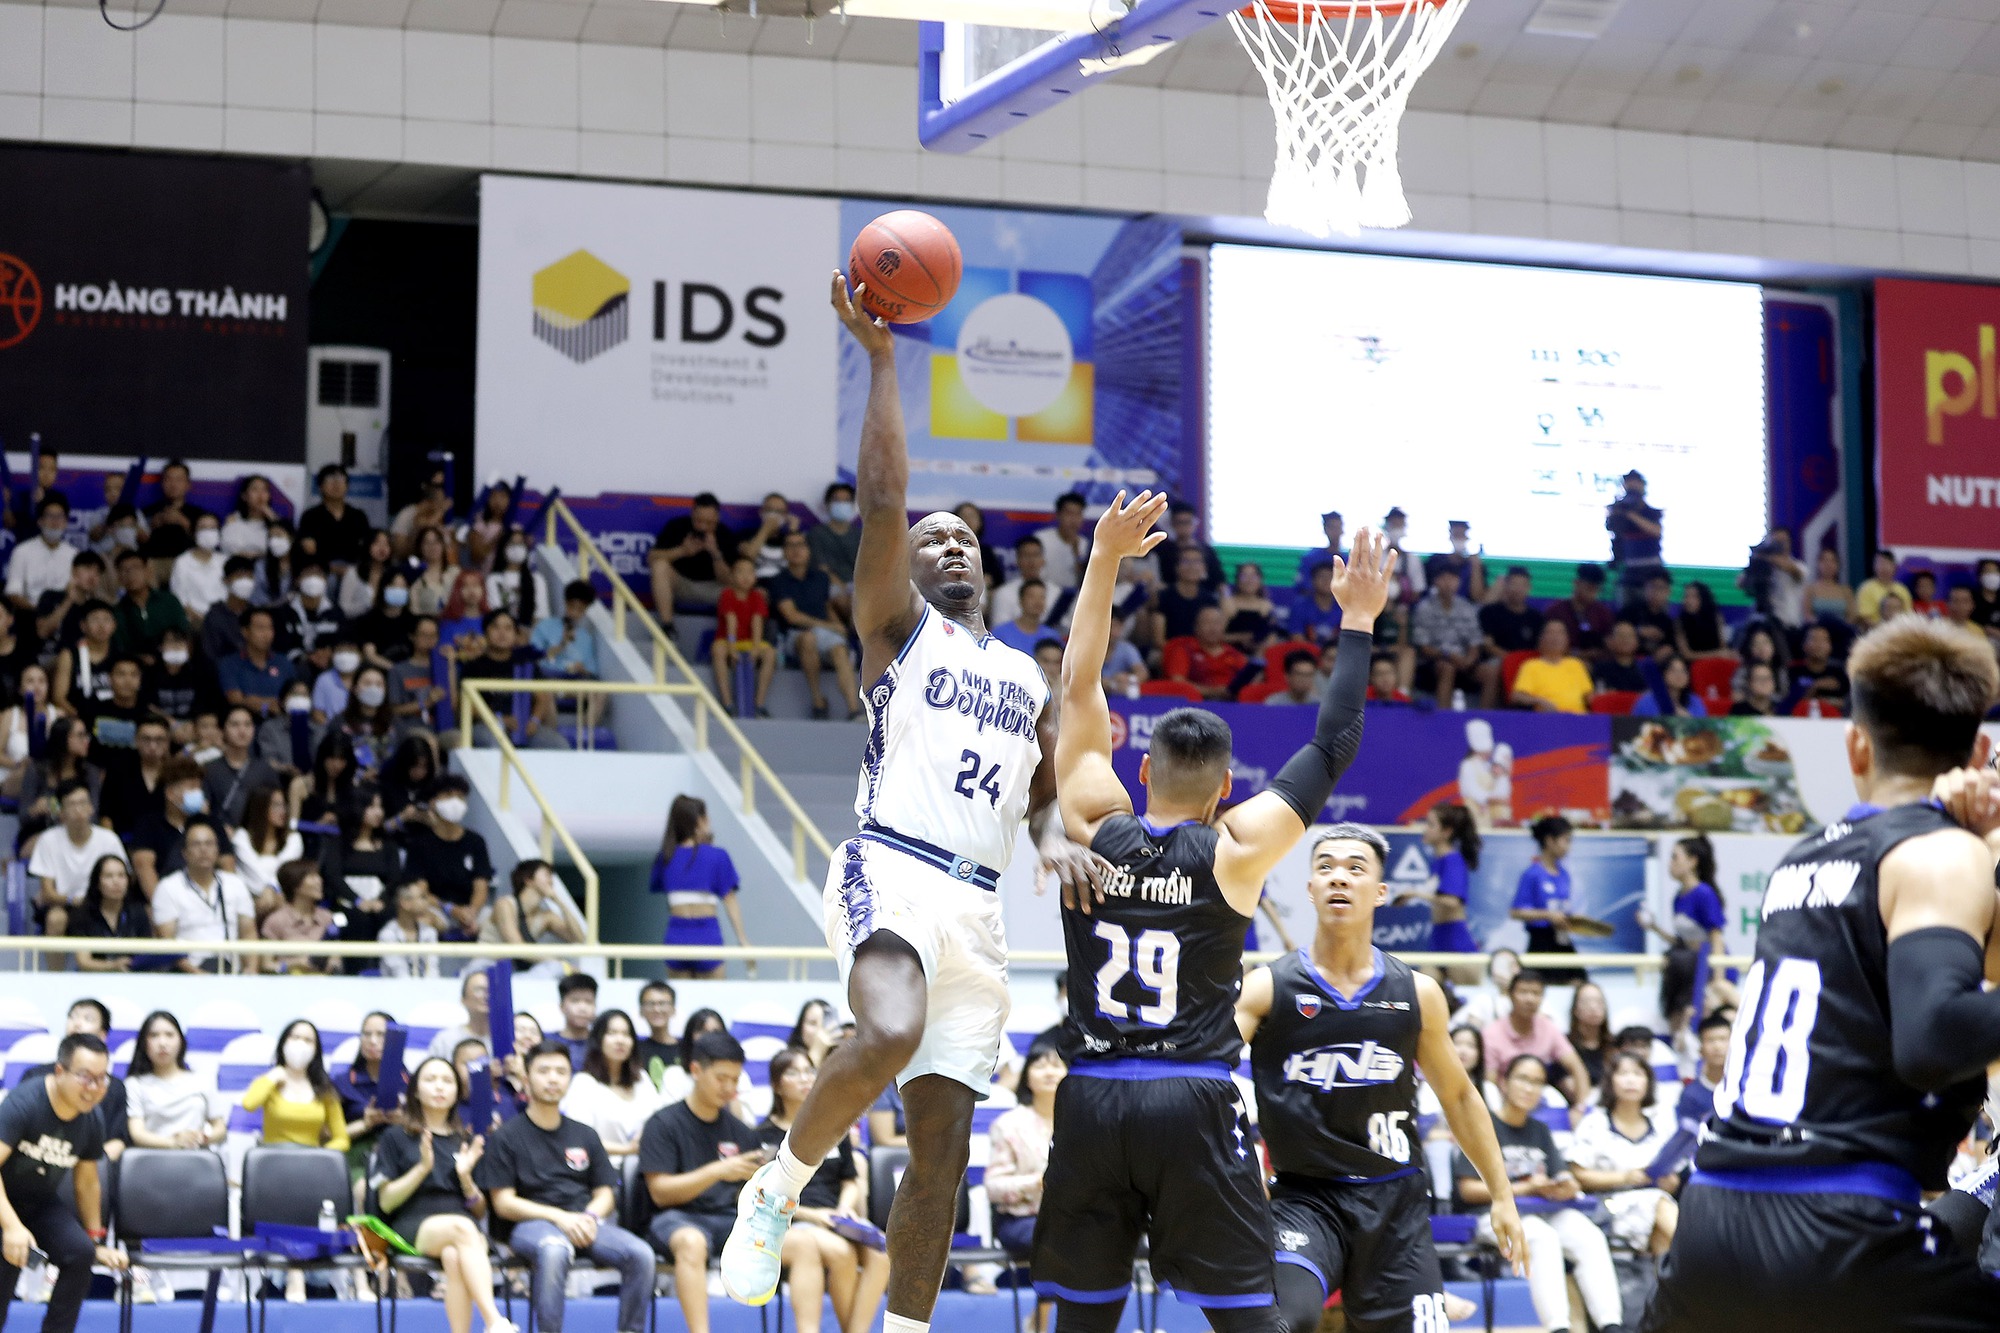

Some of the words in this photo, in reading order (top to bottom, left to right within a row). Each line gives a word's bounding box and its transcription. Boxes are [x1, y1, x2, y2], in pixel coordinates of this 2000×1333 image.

[54, 279, 172, 315] HOÀNG
[175, 285, 287, 321] THÀNH
[653, 280, 786, 348] IDS
[1925, 324, 2000, 446] pl
[923, 666, 1037, 744] Dolphins
[961, 668, 993, 697] NHA
[954, 748, 1002, 811] 24
[1093, 919, 1182, 1029] 29
